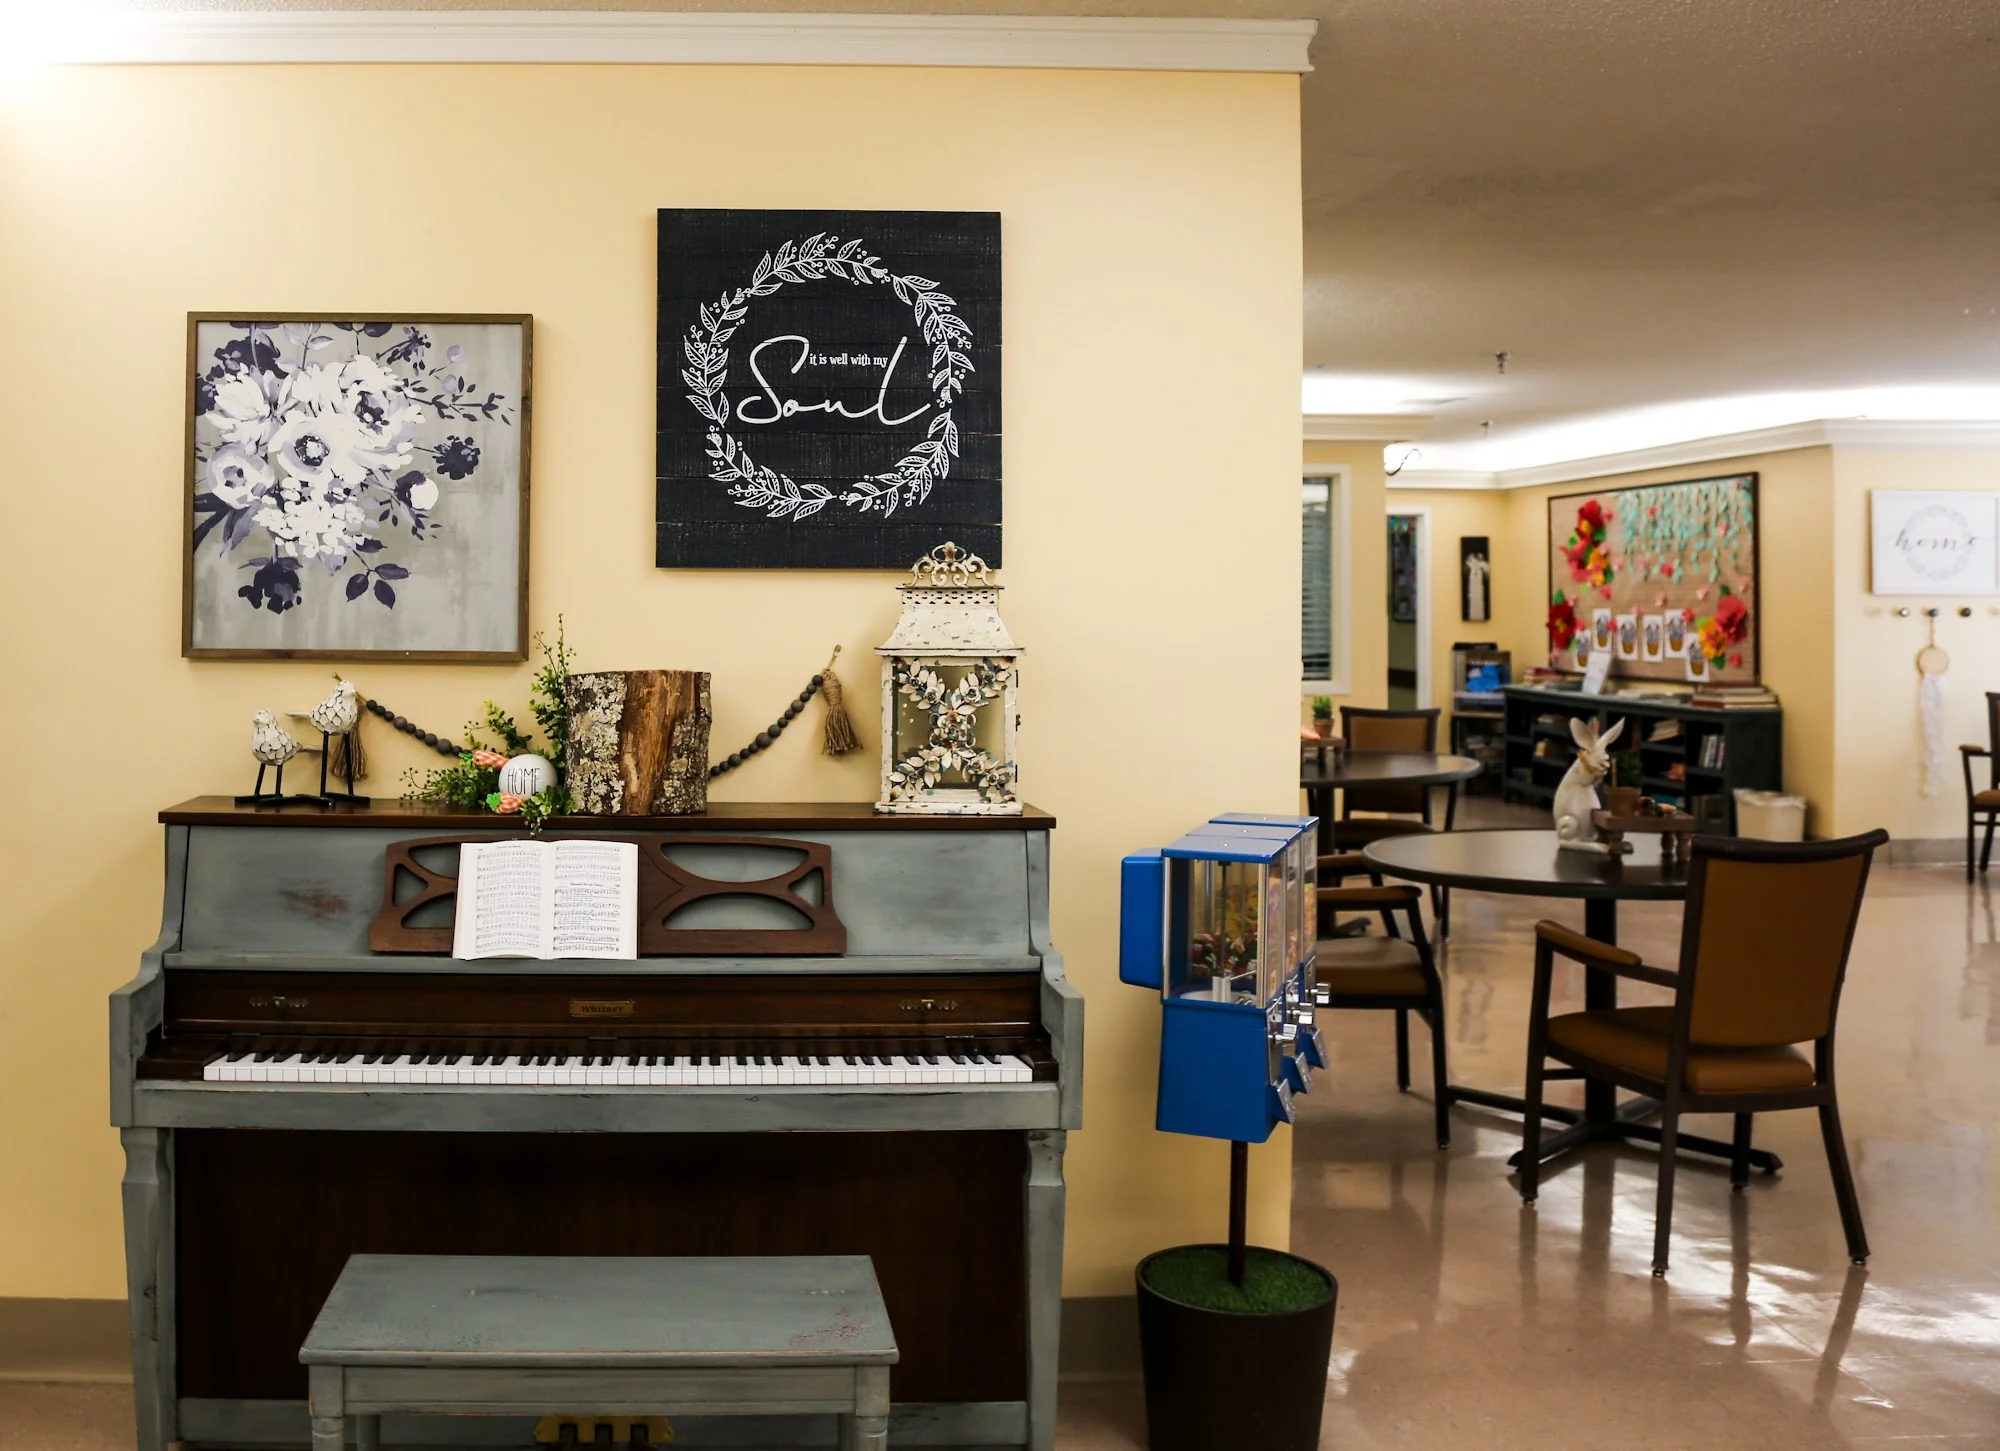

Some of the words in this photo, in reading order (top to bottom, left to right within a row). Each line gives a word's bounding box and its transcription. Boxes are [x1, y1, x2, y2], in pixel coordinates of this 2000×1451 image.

[809, 353, 818, 366] it
[818, 353, 828, 365] is
[829, 352, 849, 365] well
[850, 353, 872, 367] with
[873, 356, 889, 368] my
[736, 334, 931, 425] Soul
[507, 767, 541, 795] HOME
